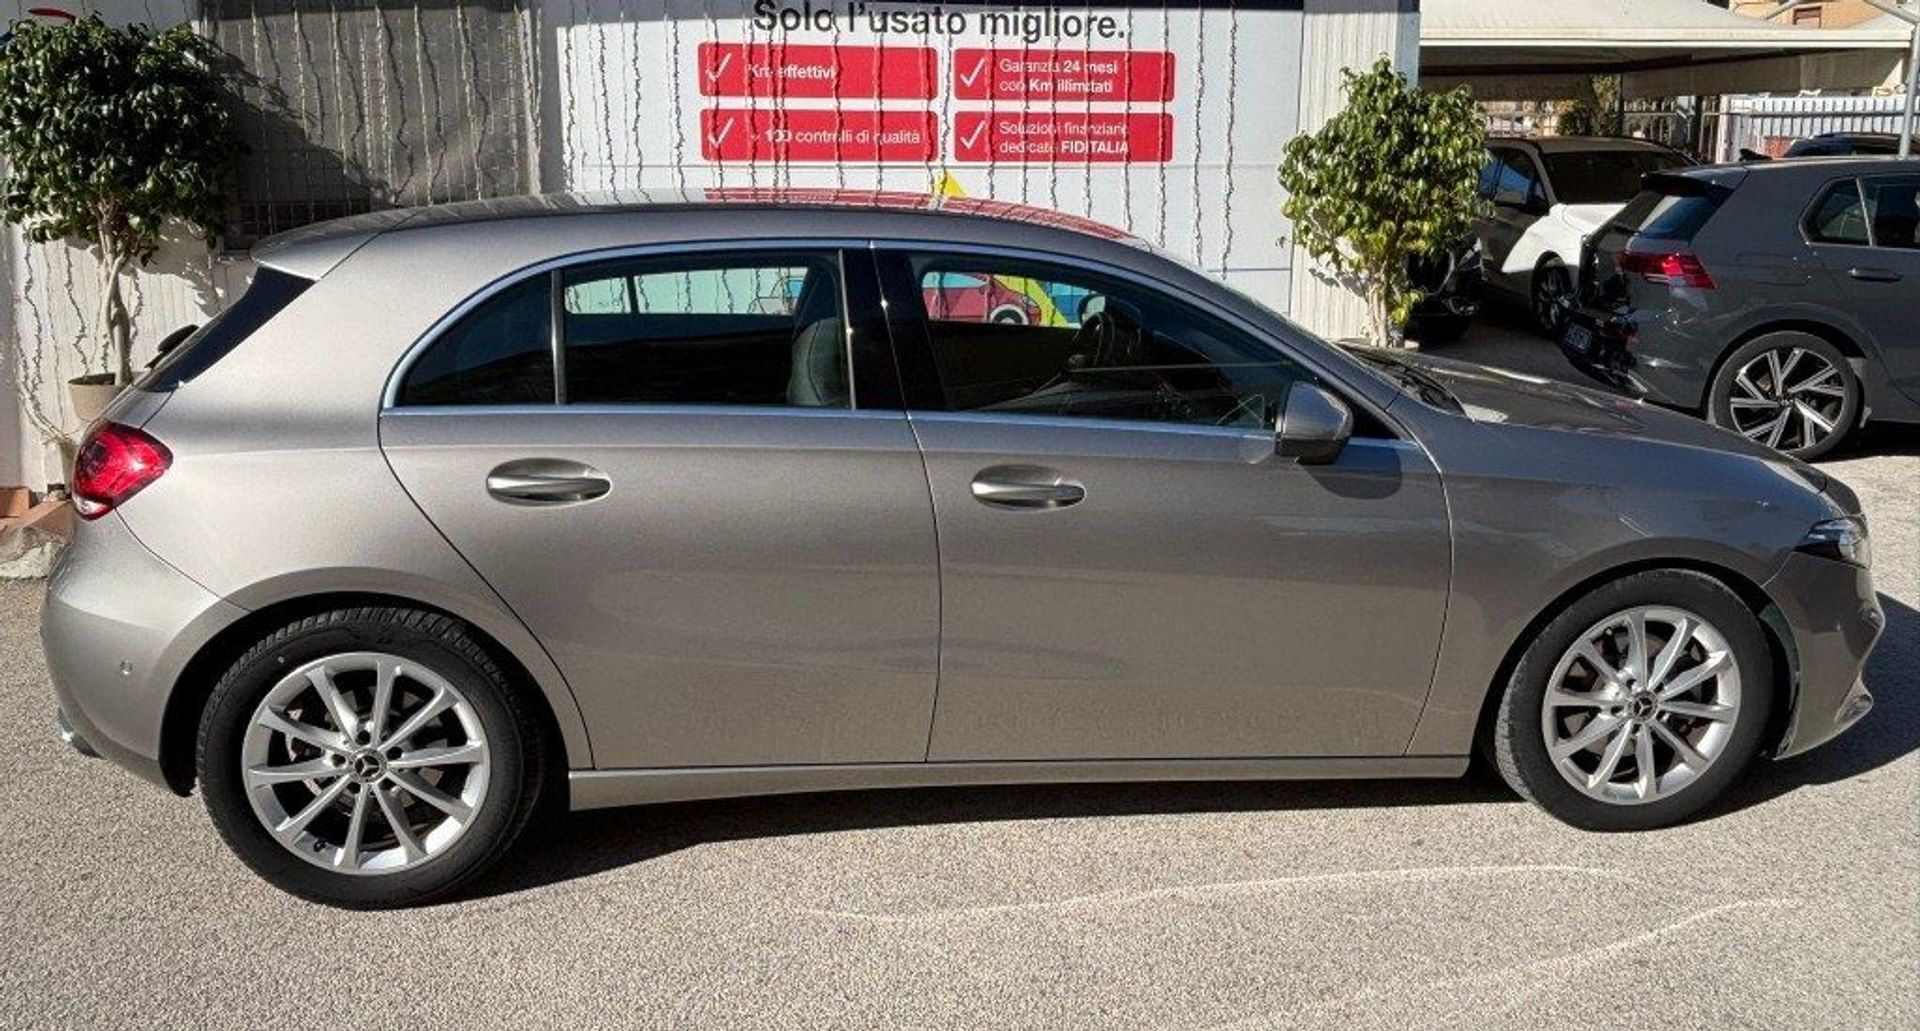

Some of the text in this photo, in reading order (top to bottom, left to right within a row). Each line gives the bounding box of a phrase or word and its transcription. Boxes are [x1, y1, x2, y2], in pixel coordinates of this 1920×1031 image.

[754, 0, 833, 31] Solo
[980, 6, 1124, 43] migliore.
[777, 63, 836, 79] effettivi
[1000, 58, 1060, 73] Garanzia
[1063, 59, 1081, 73] 24
[1000, 80, 1025, 91] con
[1029, 79, 1053, 92] Km
[765, 129, 792, 143] 100
[856, 129, 870, 144] di
[1061, 140, 1129, 153] FIDITALIA
